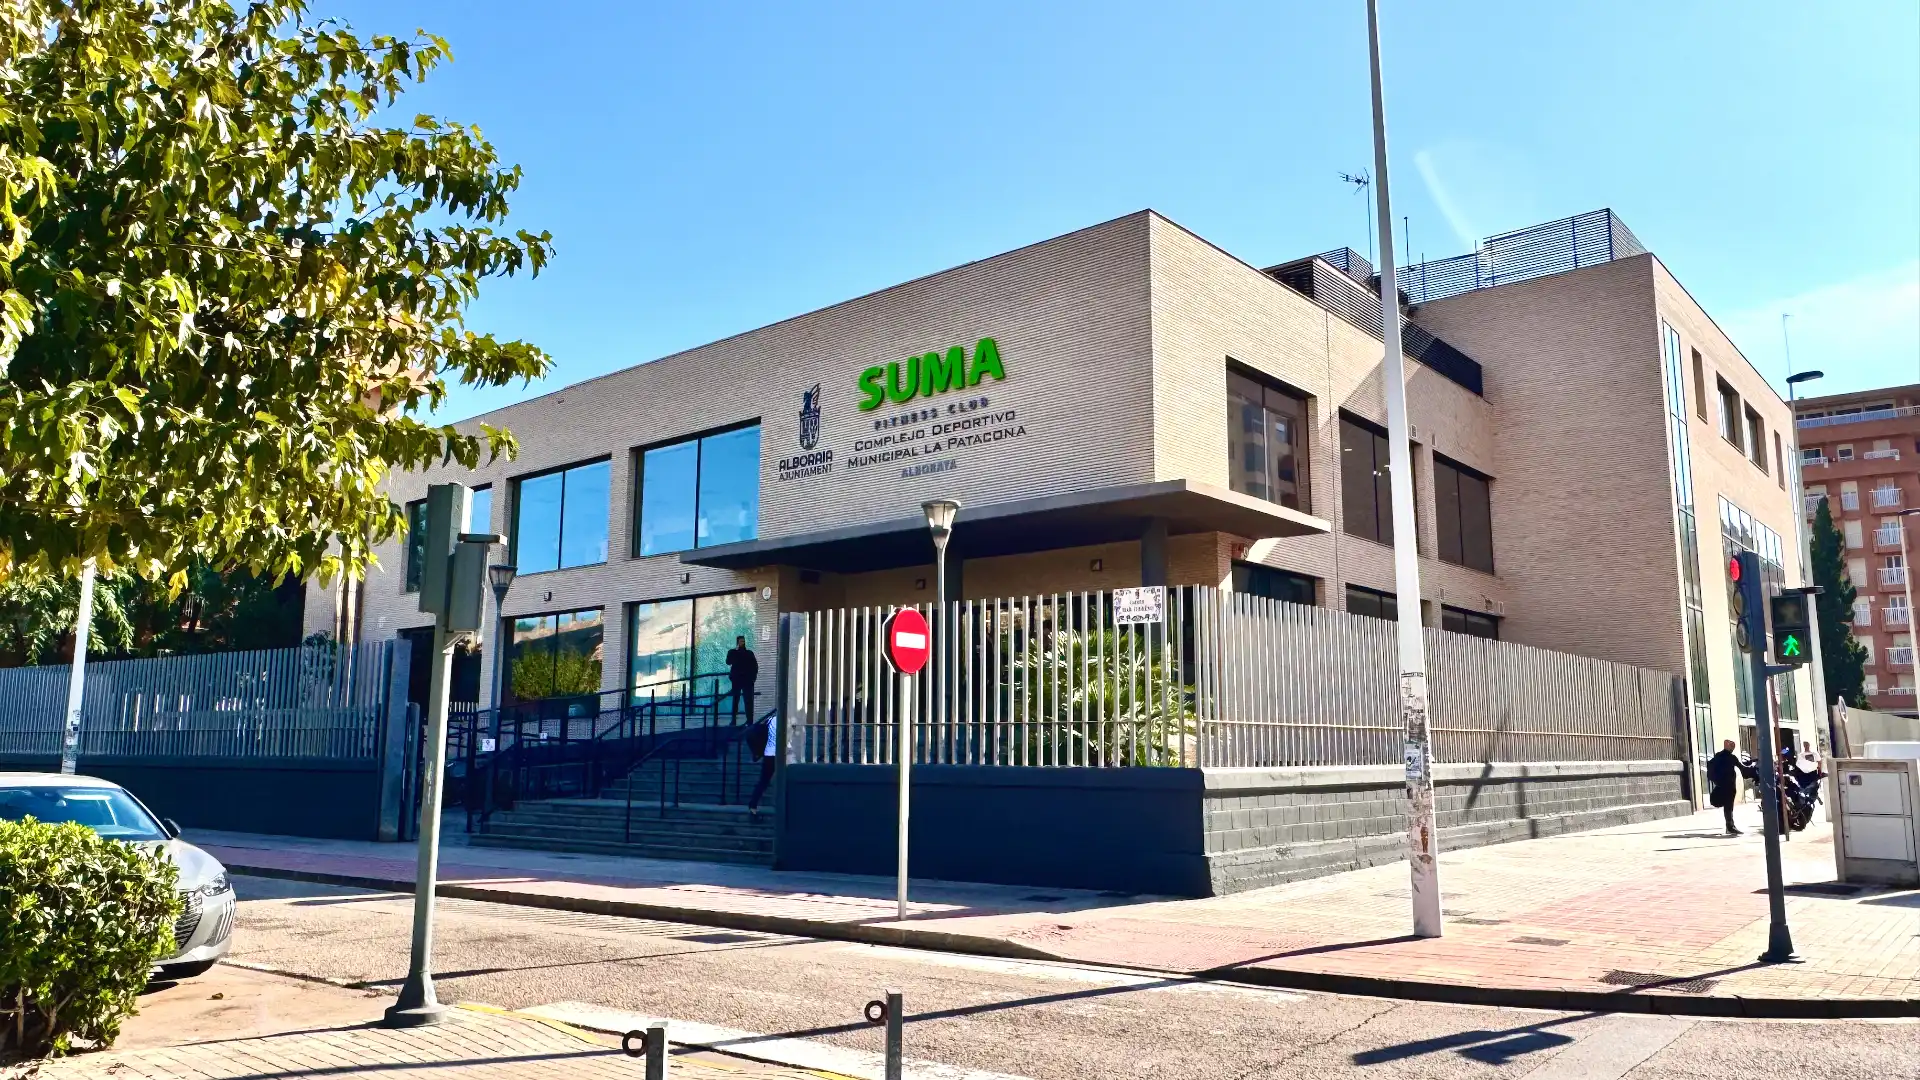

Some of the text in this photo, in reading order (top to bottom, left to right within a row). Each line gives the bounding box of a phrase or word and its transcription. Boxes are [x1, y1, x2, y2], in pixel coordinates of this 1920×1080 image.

[857, 337, 1005, 411] SUMA
[854, 410, 1016, 452] COMPLEJO DEPORTIVO
[874, 397, 989, 431] FITNESS CLUB
[778, 450, 833, 472] ALBORAIA
[847, 425, 1027, 469] MUNICIPAL LA PATACONA
[778, 463, 833, 482] AJUNTAMENT
[901, 459, 957, 478] ALBORAYA
